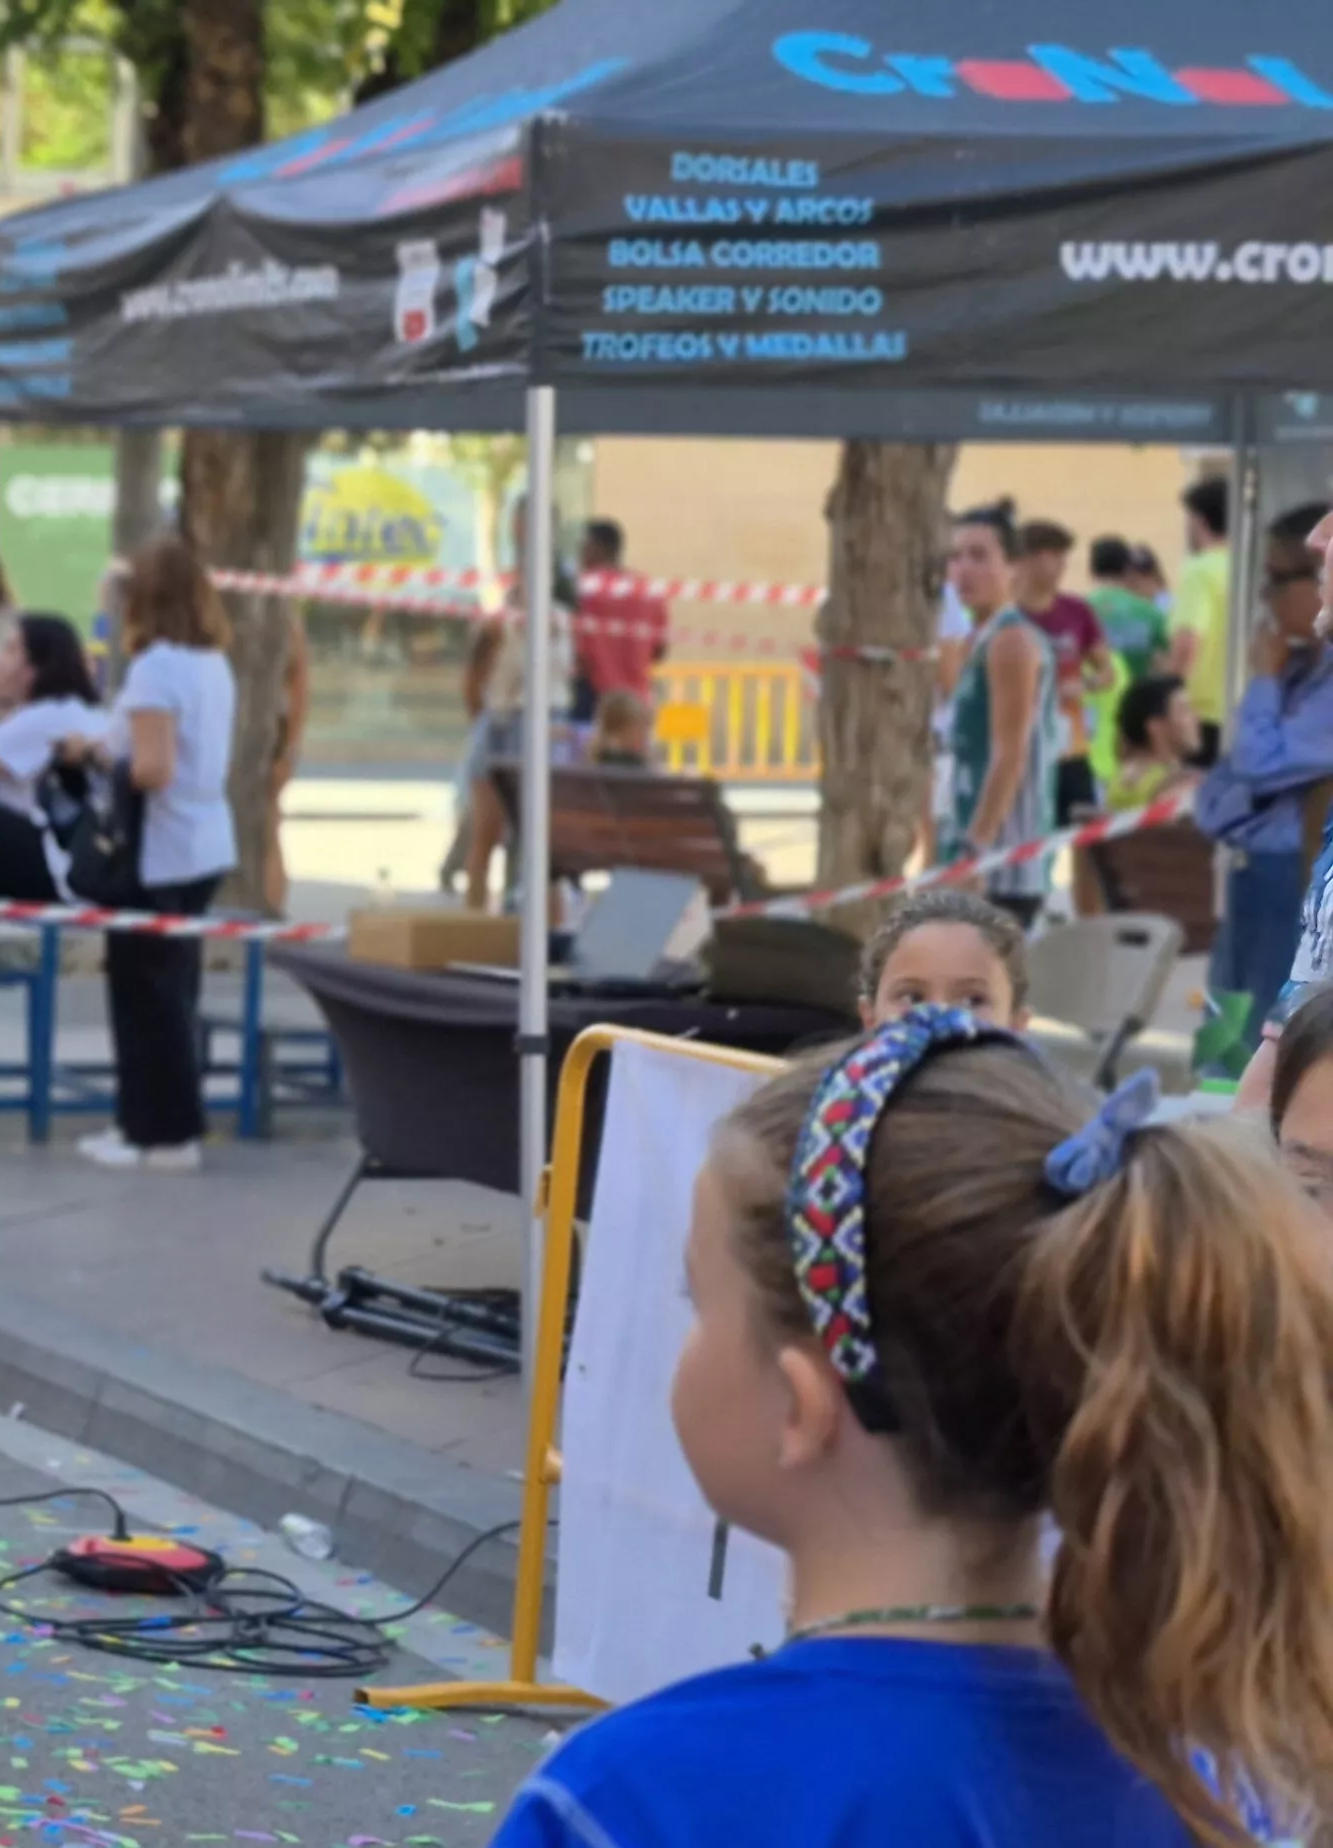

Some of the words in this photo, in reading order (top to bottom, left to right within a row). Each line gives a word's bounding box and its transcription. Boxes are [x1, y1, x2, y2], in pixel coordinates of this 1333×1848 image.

[671, 153, 818, 188] DORSALES
[624, 194, 741, 224] VALLAS
[743, 198, 769, 224] Y
[775, 197, 874, 225] ARCOS
[608, 240, 705, 268] BOLSA
[710, 241, 880, 270] CORREDOR
[602, 286, 734, 314] SPEAKER
[741, 287, 764, 313] Y
[767, 286, 883, 315] SONIDO
[581, 332, 713, 361] TROFEOS
[717, 333, 742, 360] Y
[744, 330, 909, 361] MEDALLAS
